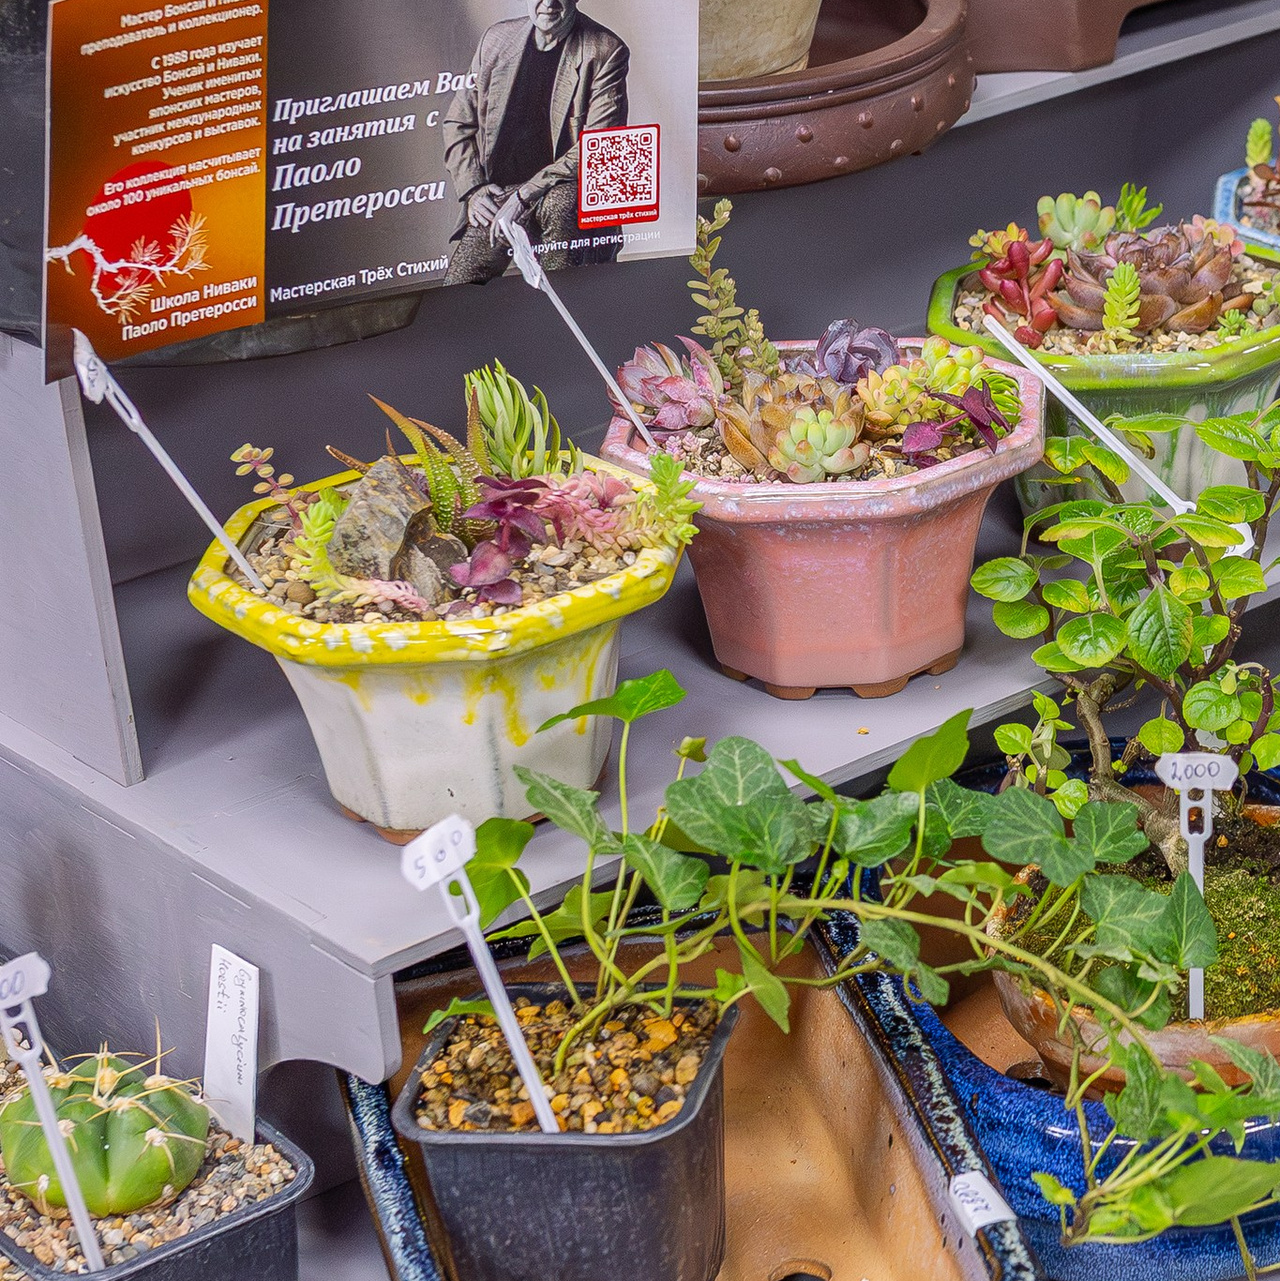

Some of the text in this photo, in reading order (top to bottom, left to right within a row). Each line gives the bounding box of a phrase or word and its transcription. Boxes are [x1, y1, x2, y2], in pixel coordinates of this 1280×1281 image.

[80, 3, 263, 55] преподаватель и коллекционер.
[121, 8, 163, 28] Мастер
[103, 51, 263, 99] искусство Бонсай и Ниваки.
[151, 56, 161, 70] С
[189, 45, 217, 61] года
[217, 35, 263, 55] изучает
[148, 84, 262, 119] японских мастеров,
[162, 67, 262, 100] Ученик именитых
[272, 71, 478, 124] Приглашаем Вас
[113, 99, 262, 147] участник международных
[131, 116, 262, 156] конкурсов и выставок.
[272, 110, 440, 155] на занятия с
[86, 161, 261, 217] около 100 уникальных бонсай.
[103, 146, 262, 196] Его коллекция насчитывает
[271, 156, 362, 192] Паоло
[271, 180, 446, 234] Претеросси
[580, 208, 658, 223] мастерская трёх стихий
[507, 230, 661, 257] сируйте для регистрации
[150, 276, 258, 313] Школа Ниваки
[269, 254, 449, 303] Мастерская Трёх Стихий
[121, 295, 257, 341] Паоло Претеросси
